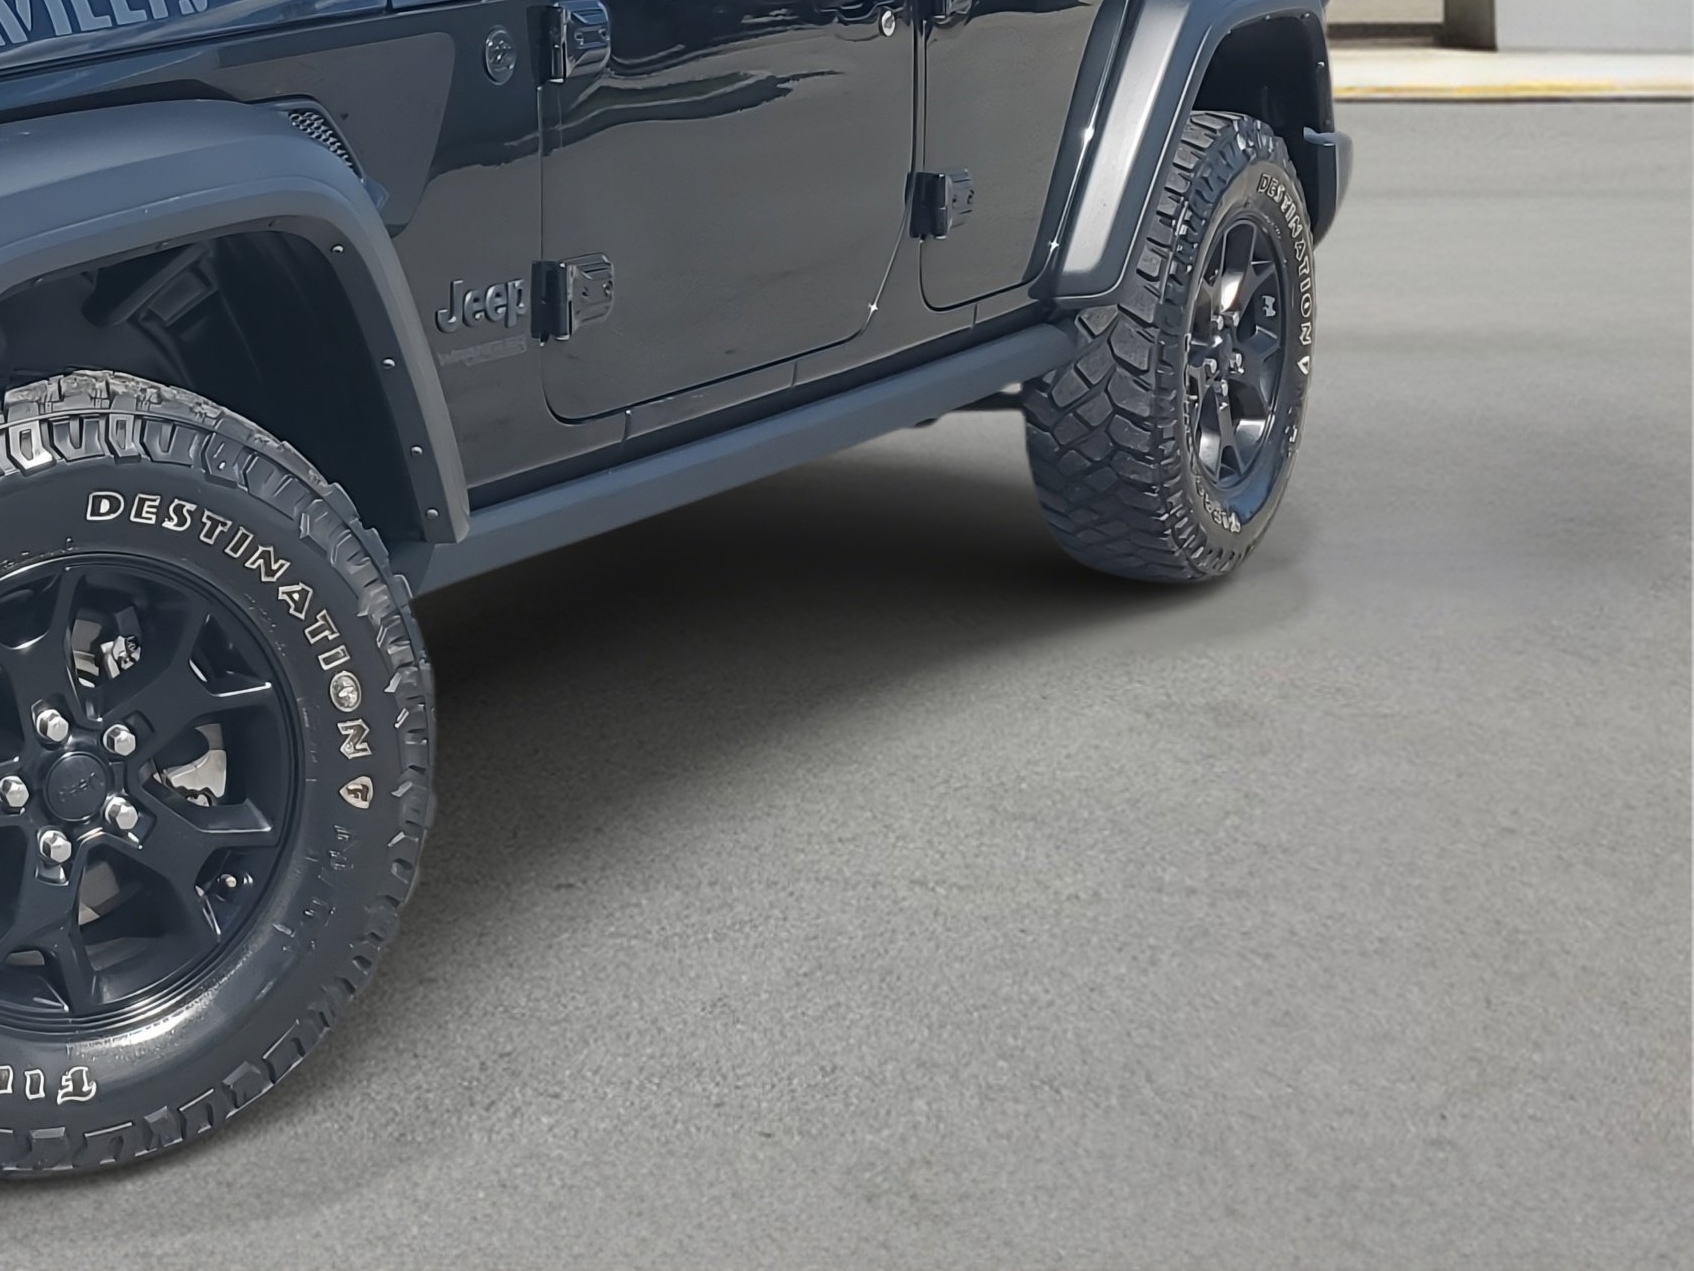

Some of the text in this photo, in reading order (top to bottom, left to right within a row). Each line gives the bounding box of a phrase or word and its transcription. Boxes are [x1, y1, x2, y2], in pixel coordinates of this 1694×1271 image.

[435, 279, 527, 332] Jeep
[1257, 173, 1313, 345] DESTINATION
[86, 490, 372, 760] DESTINATION
